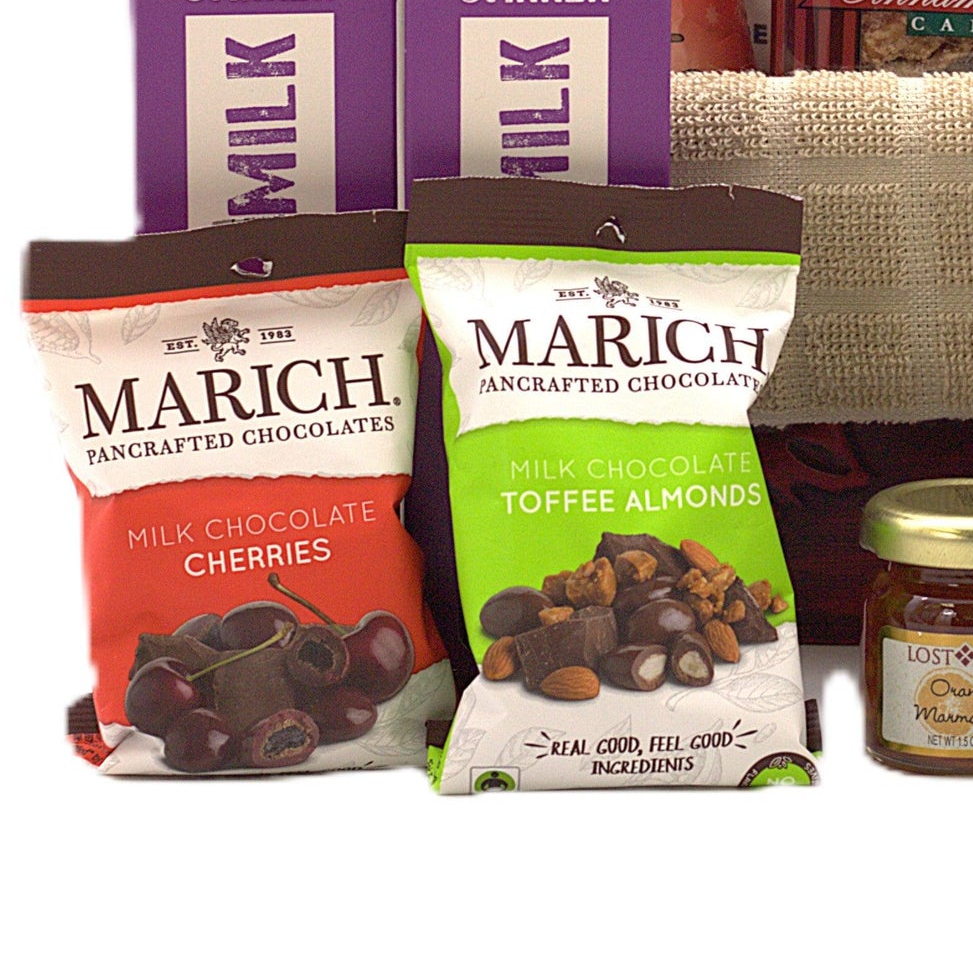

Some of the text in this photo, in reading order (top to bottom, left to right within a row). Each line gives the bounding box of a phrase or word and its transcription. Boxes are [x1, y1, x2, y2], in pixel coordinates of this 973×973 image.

[225, 33, 297, 216] MILK
[166, 328, 293, 352] EST. 1983
[467, 314, 769, 376] MARICH
[479, 371, 763, 395] PANCRAFTED CHOCOLATE
[86, 416, 395, 466] PANCRAFTED CHOCOLATES
[511, 451, 752, 481] MILK CHOCOLATE
[500, 482, 763, 515] TOFFEE ALMONDS
[127, 500, 377, 550] MILK CHOCOLATE
[184, 537, 332, 577] CHERRIES
[907, 645, 955, 666] LOST
[551, 731, 733, 757] REAL GOOD, FEEL GOOD
[927, 735, 942, 745] NET
[943, 735, 956, 746] WT
[957, 735, 968, 746] 1.5
[590, 756, 694, 775] INGREDIENTS
